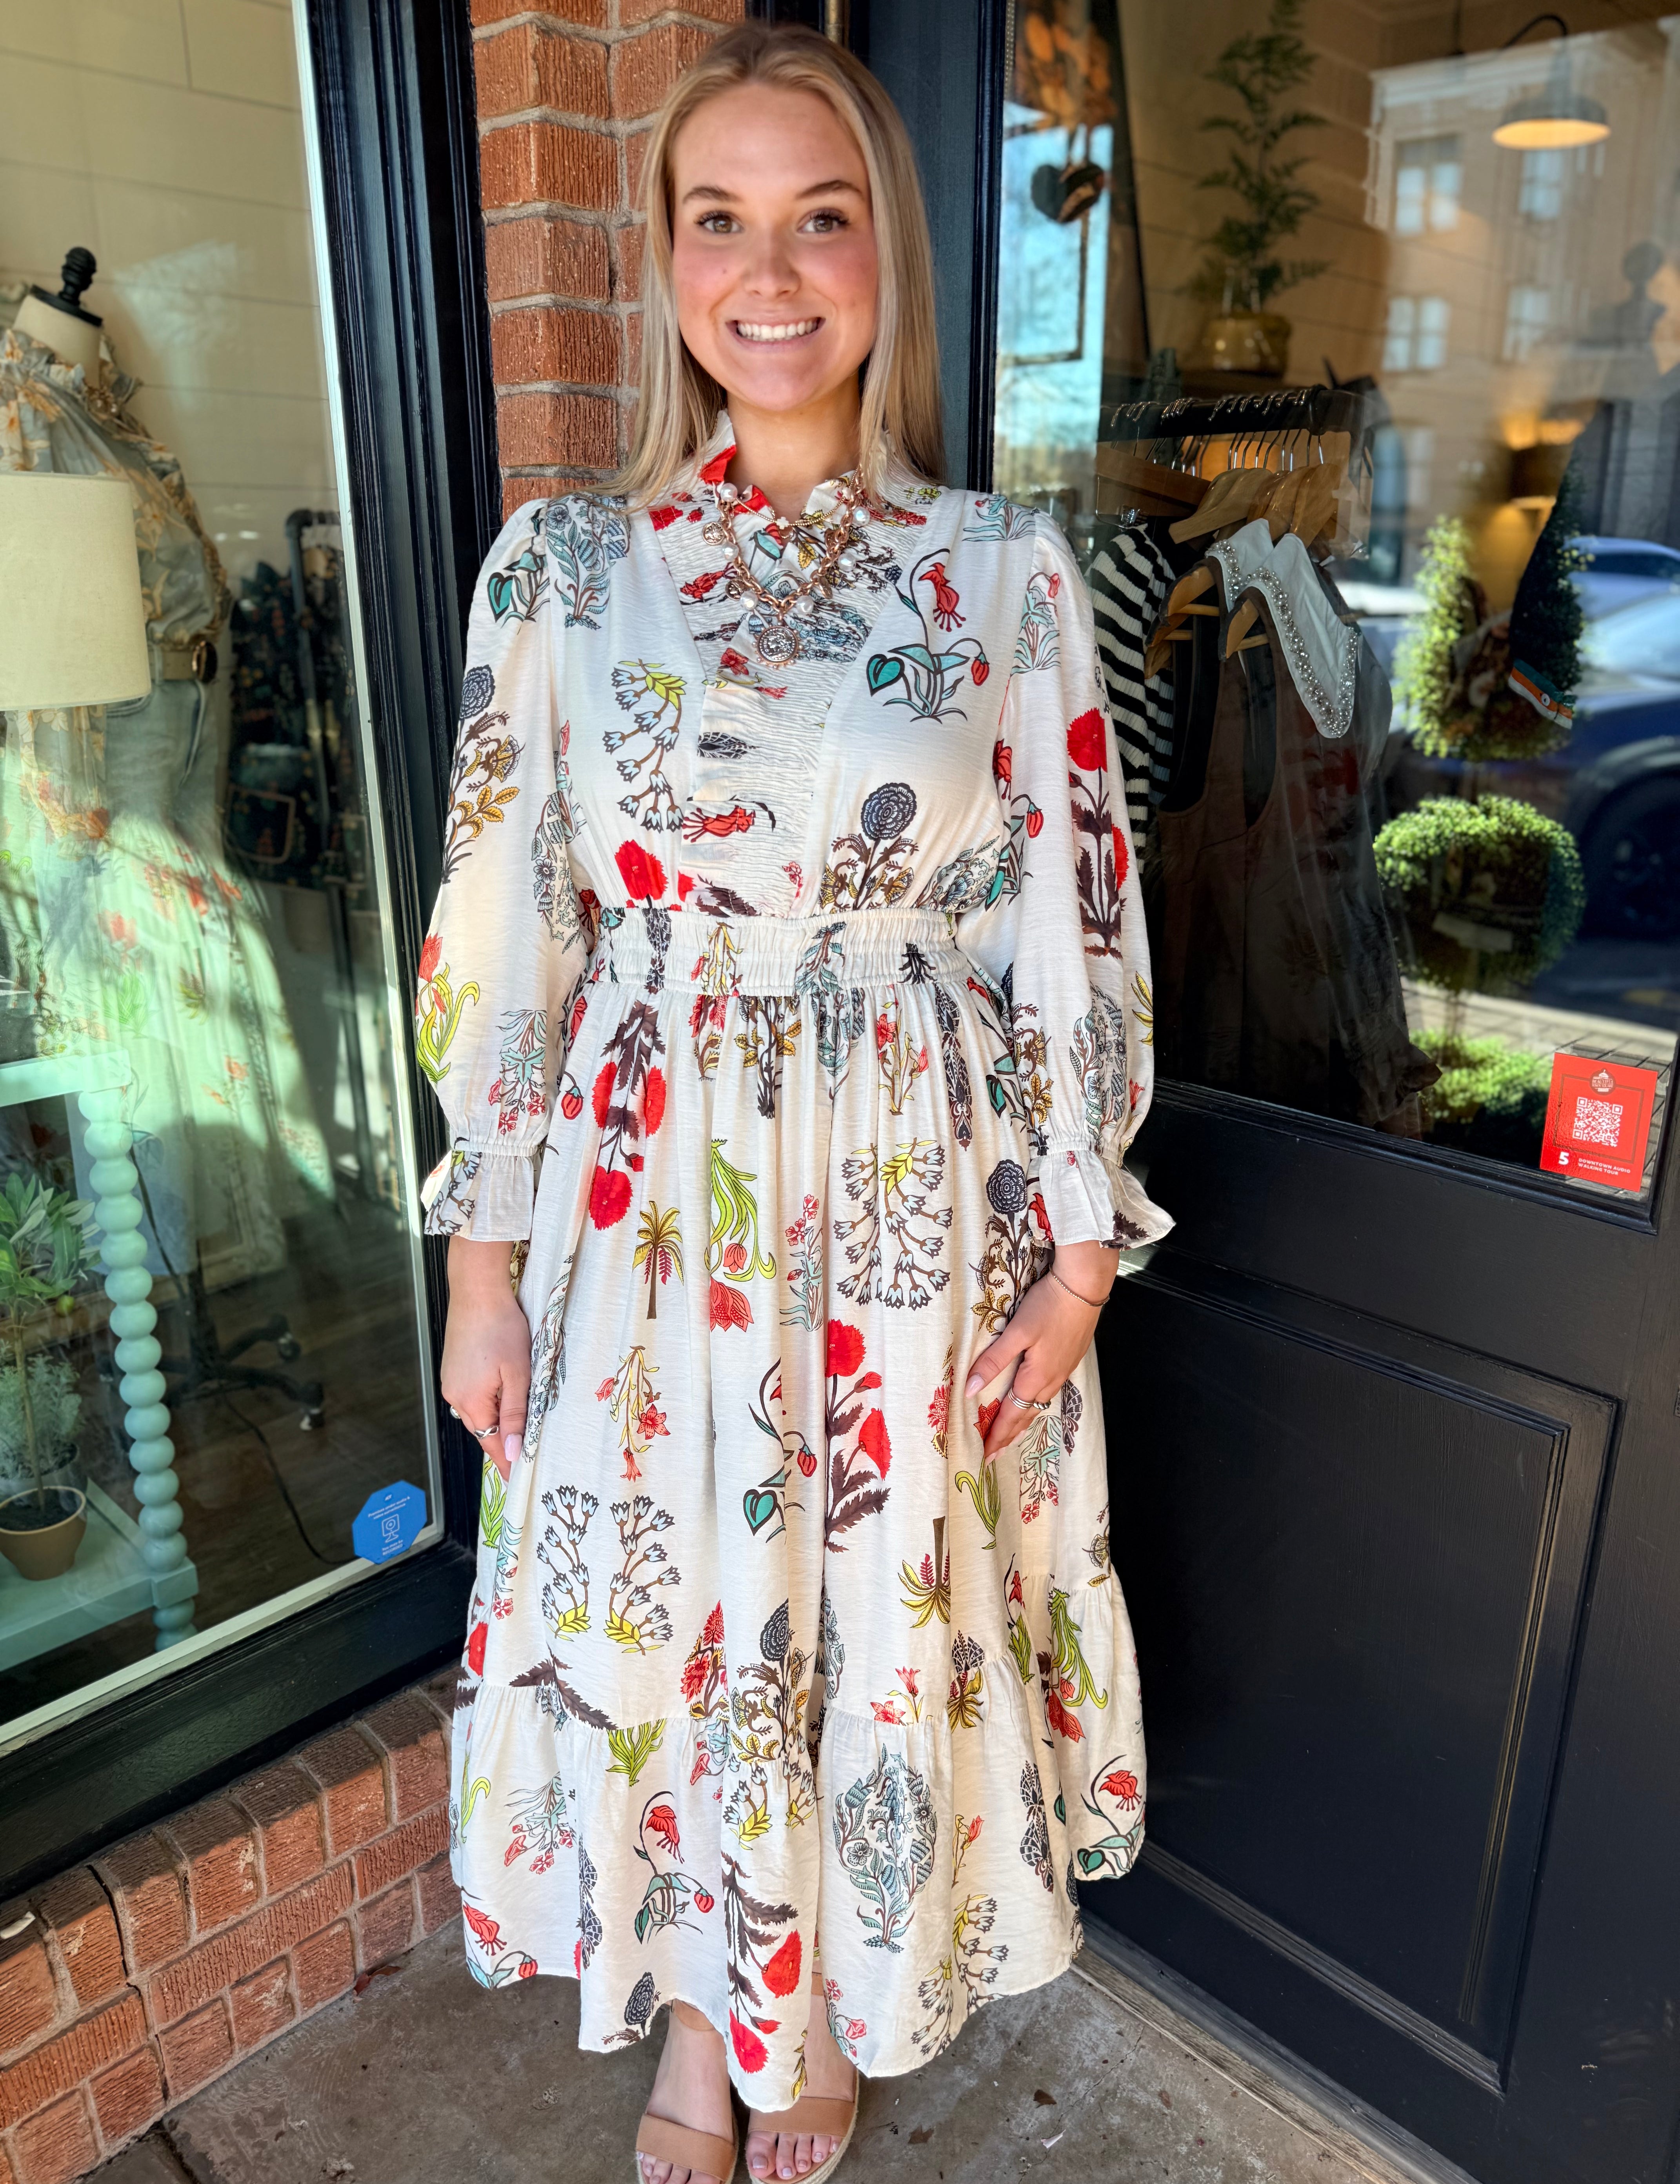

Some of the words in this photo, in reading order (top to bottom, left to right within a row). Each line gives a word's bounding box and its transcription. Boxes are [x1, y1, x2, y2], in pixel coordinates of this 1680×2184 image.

[1558, 1151, 1569, 1165] 5
[1578, 1158, 1613, 1169] DOWNTOWN
[1578, 1163, 1603, 1172] WALKING
